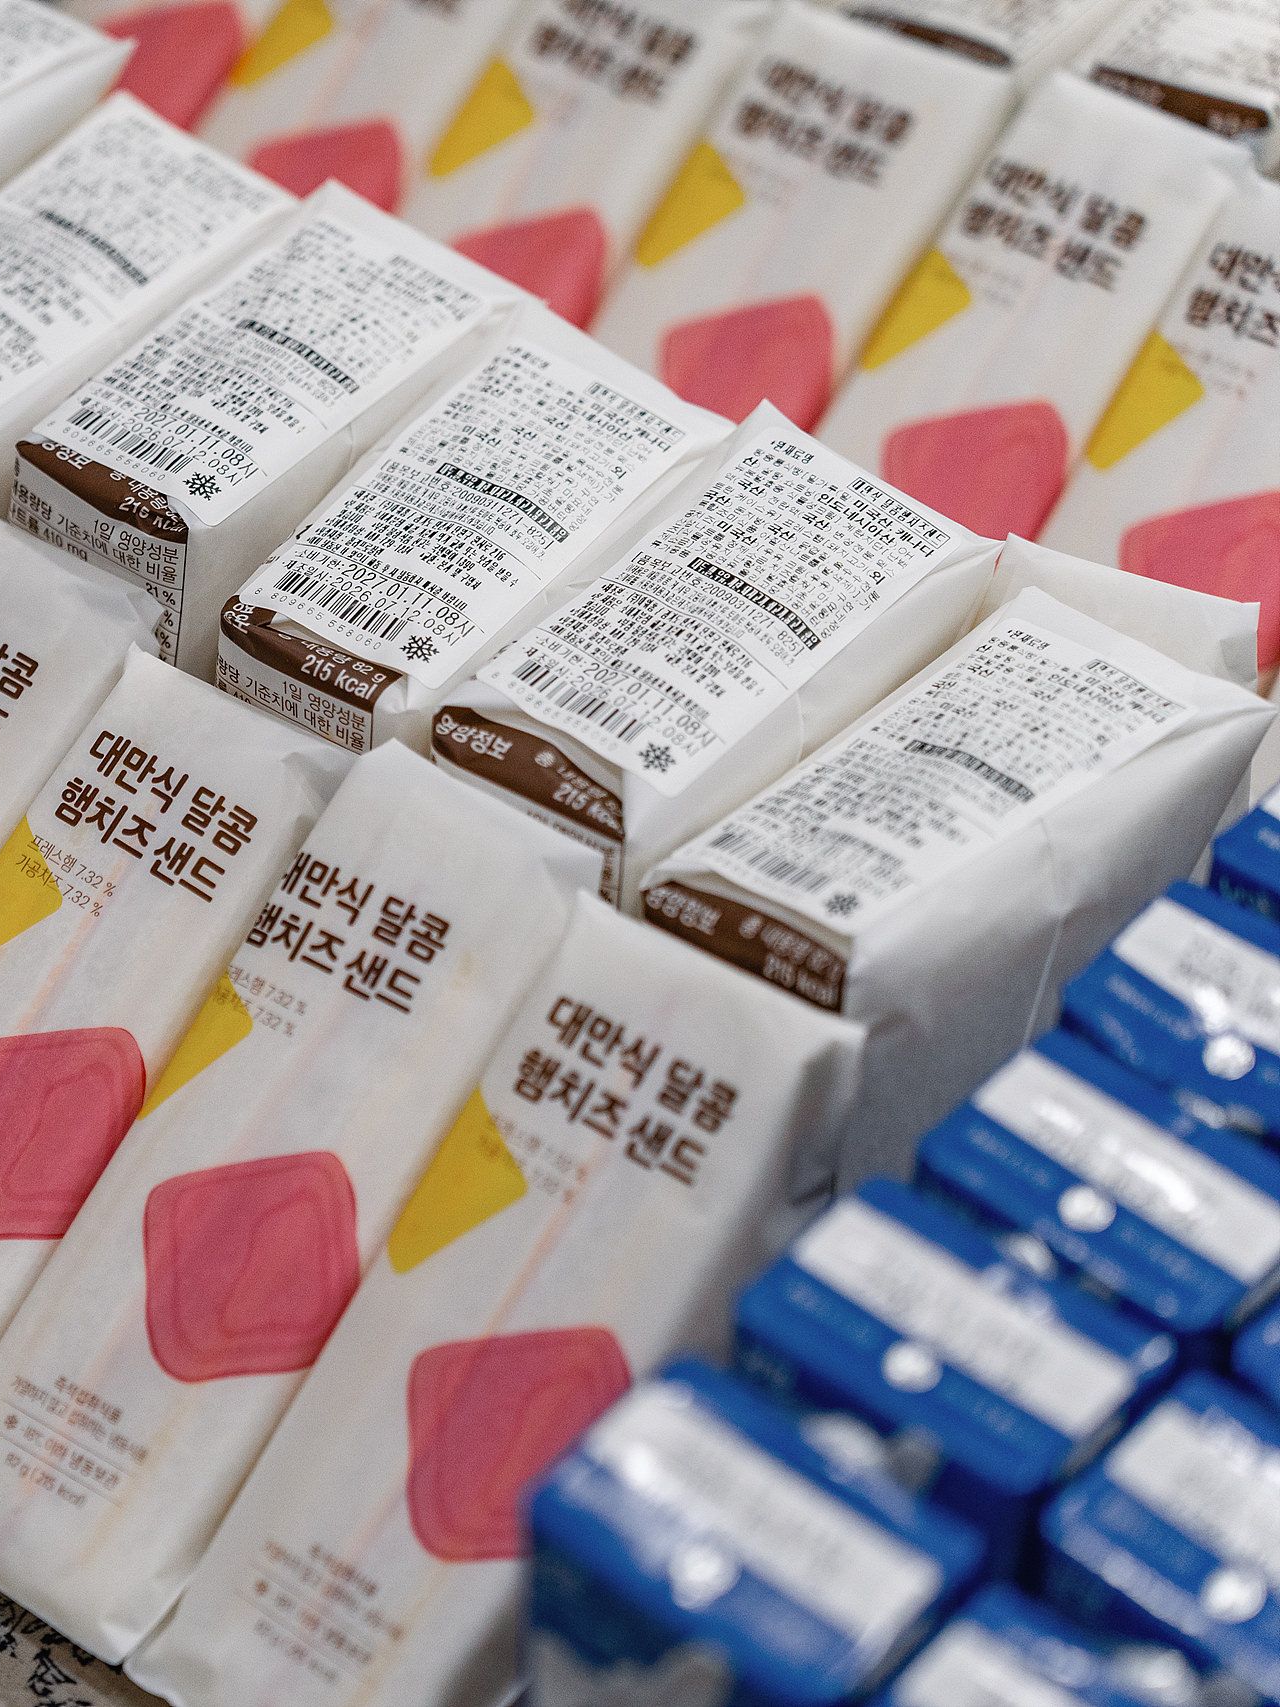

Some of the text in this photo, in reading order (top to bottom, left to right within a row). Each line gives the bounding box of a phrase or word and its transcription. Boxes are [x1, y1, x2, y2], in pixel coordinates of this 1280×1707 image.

[1208, 241, 1280, 295] 대만
[122, 418, 246, 487] 2026.07.12.08시
[131, 406, 261, 479] 2027.01.11.08시
[849, 478, 884, 503] 대만식
[42, 527, 88, 563] 410 mg
[56, 512, 177, 584] 기준치에 대한 비율
[93, 519, 179, 566] 1일 영양성분
[411, 513, 436, 527] 경기도
[431, 520, 455, 532] 안산시
[449, 524, 474, 541] 단원구
[487, 546, 507, 561] 216
[428, 542, 459, 562] 국번없이
[454, 556, 476, 572] 1399
[461, 545, 480, 560] 또는
[475, 554, 499, 573] 보상을
[493, 566, 513, 582] 받을
[145, 581, 176, 606] 21 %
[329, 575, 461, 647] 2026.07.12.08시
[340, 561, 475, 638] 2027.01.11.08시
[457, 572, 482, 590] 구입처
[254, 587, 263, 596] 8
[271, 593, 324, 621] 809665
[327, 620, 382, 650] 558060
[301, 655, 378, 701] 215 kcal
[352, 661, 387, 684] 82 g
[581, 661, 718, 748] 2027.01.11.08시
[245, 676, 366, 752] 기준치에 대한 비율
[282, 681, 366, 733] 1일 영양성분
[435, 714, 514, 761] 영양정보
[89, 730, 258, 856] 대만식 달콤
[553, 783, 589, 811] 215
[31, 833, 118, 898] 프레스햄 7.32 %
[54, 777, 225, 903] 햄치즈 샌드
[15, 853, 103, 918] 가공치즈 7.32 %
[245, 903, 421, 1015] 햄치즈 샌드
[370, 895, 451, 965] 달콤
[547, 996, 740, 1135] 대만식 달콤
[513, 1047, 630, 1139] 햄치즈
[621, 1112, 707, 1187] 샌드
